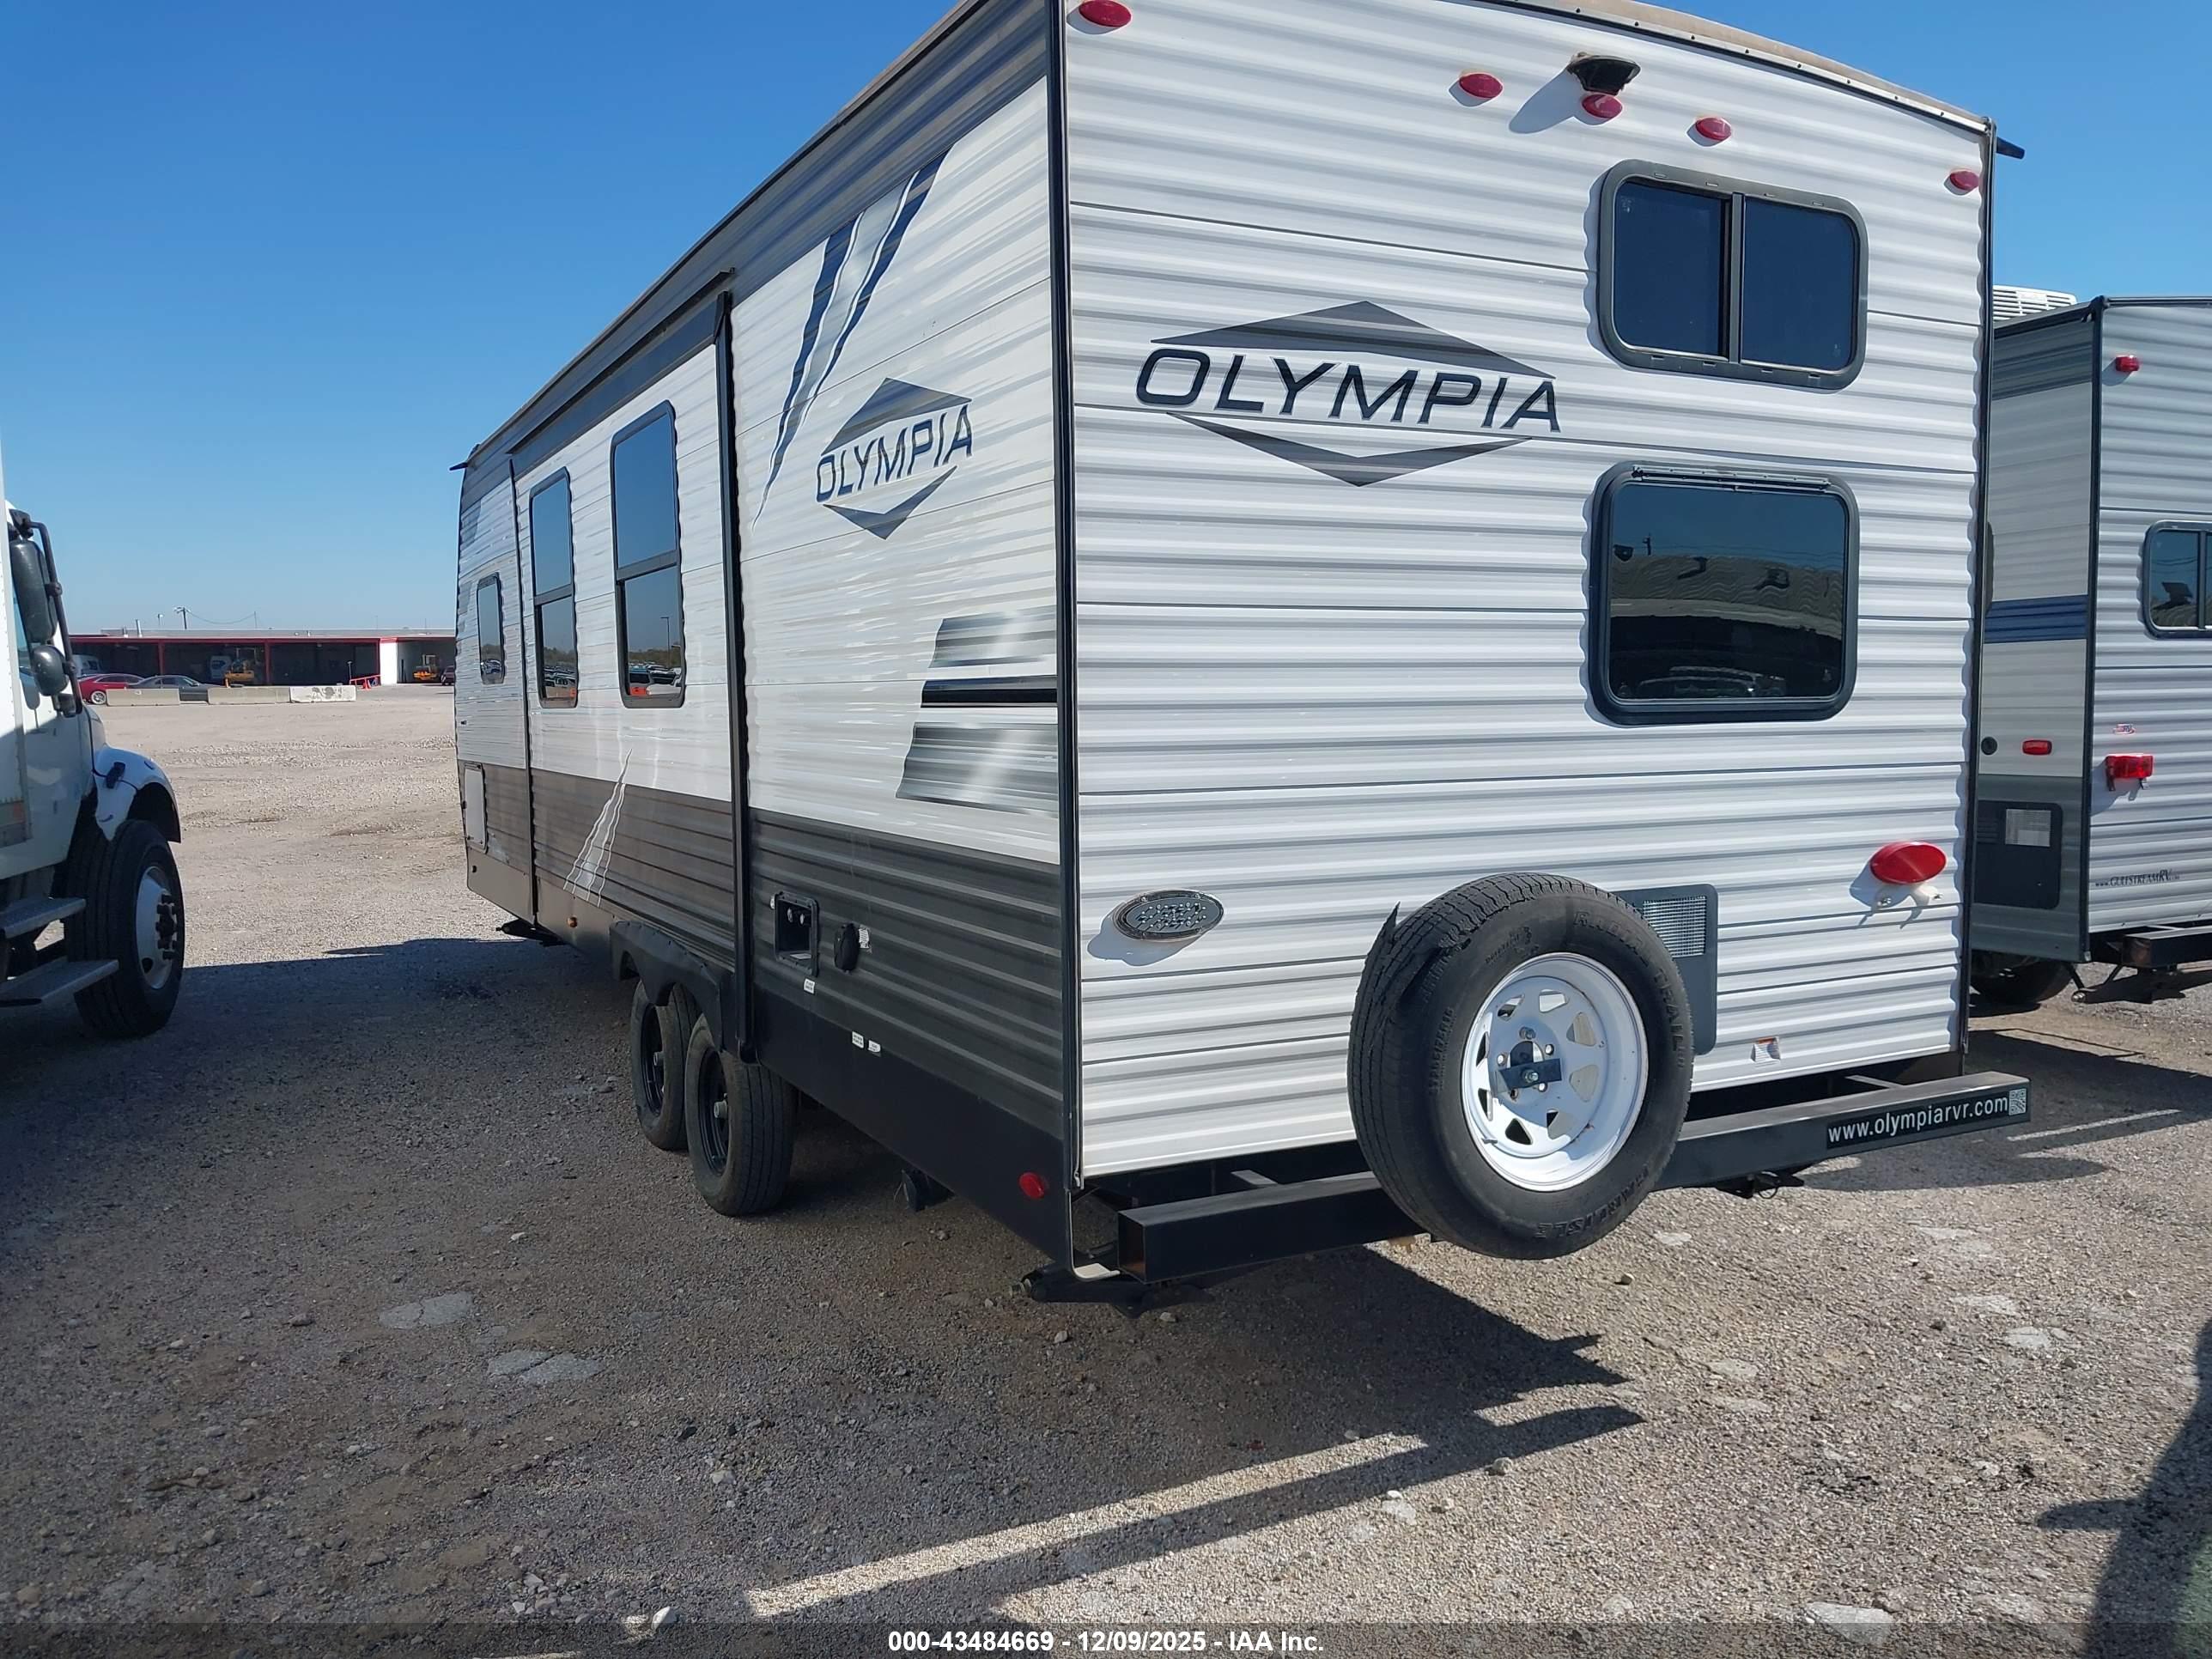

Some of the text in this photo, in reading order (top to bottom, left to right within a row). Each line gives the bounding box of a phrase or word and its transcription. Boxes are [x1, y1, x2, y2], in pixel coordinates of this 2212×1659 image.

[1135, 347, 1562, 434] OLYMPIA
[816, 404, 973, 503] OLYMPIA
[1827, 1095, 2009, 1144] www.olympiarvr.com
[1534, 1163, 1650, 1239] CARLISLE
